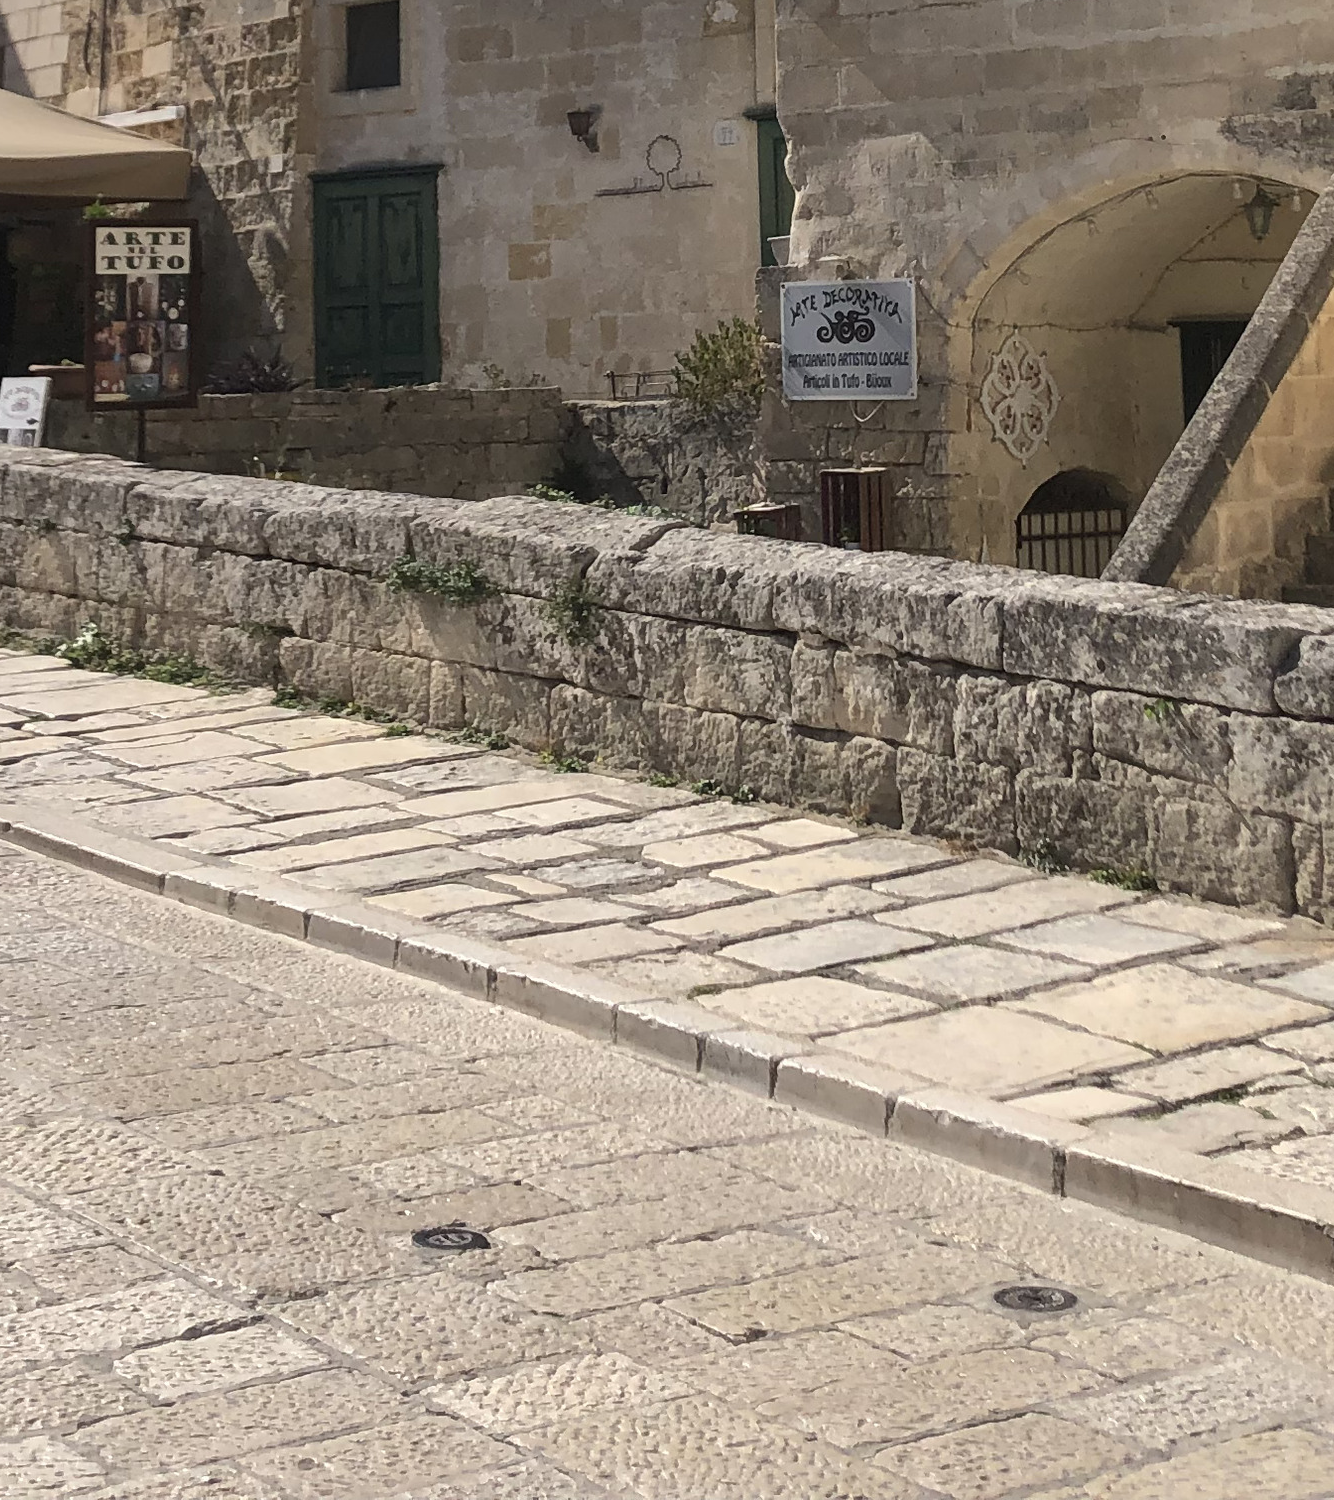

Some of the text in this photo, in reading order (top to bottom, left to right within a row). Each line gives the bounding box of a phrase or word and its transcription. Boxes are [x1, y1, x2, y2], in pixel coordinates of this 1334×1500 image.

[100, 231, 186, 246] ARTE
[127, 246, 158, 255] NEL
[101, 255, 185, 270] TUFO
[789, 286, 903, 327] ARTE DECORATIVA
[787, 350, 910, 368] ARTIGIANATO ARTISTICO LOCALE
[802, 373, 831, 389] Articoli
[832, 374, 840, 389] in
[840, 373, 860, 389] Tufo
